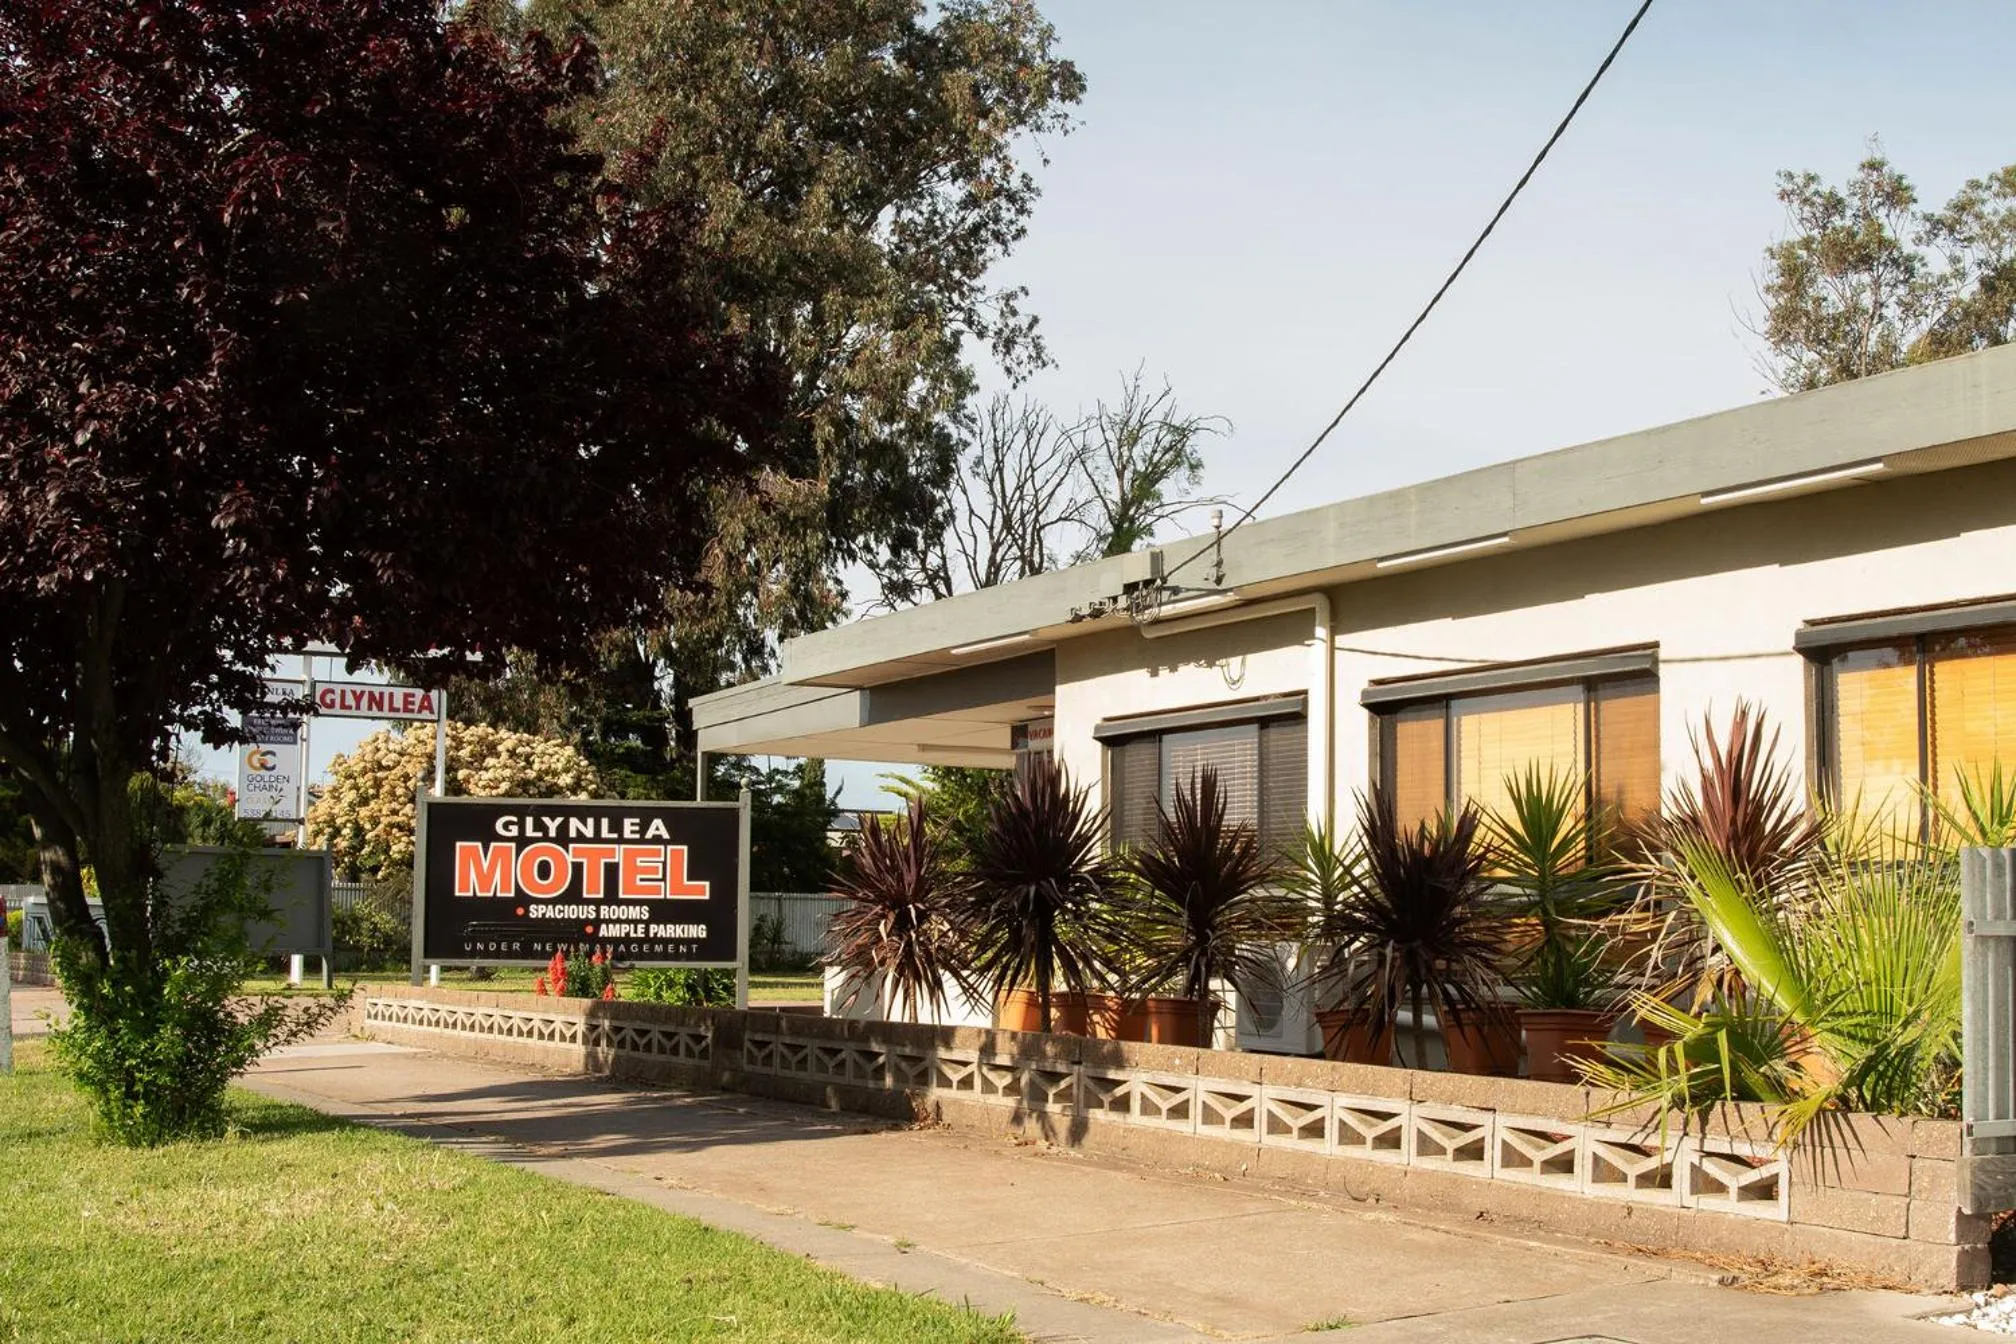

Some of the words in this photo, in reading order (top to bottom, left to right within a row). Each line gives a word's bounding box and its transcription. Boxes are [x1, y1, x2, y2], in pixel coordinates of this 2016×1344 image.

[319, 688, 435, 714] GLYNLEA
[246, 774, 290, 784] GOLDEN
[246, 783, 279, 793] CHAIN
[495, 815, 670, 839] GLYNLEA
[454, 841, 711, 900] MOTEL
[529, 904, 596, 918] SPACIOUS
[600, 905, 650, 919] ROOMS
[599, 924, 645, 938] AMPLE
[649, 925, 707, 938] PARKING
[464, 942, 521, 951] UNDER
[534, 942, 568, 951] NEW
[579, 943, 699, 953] MANAGEMENT
